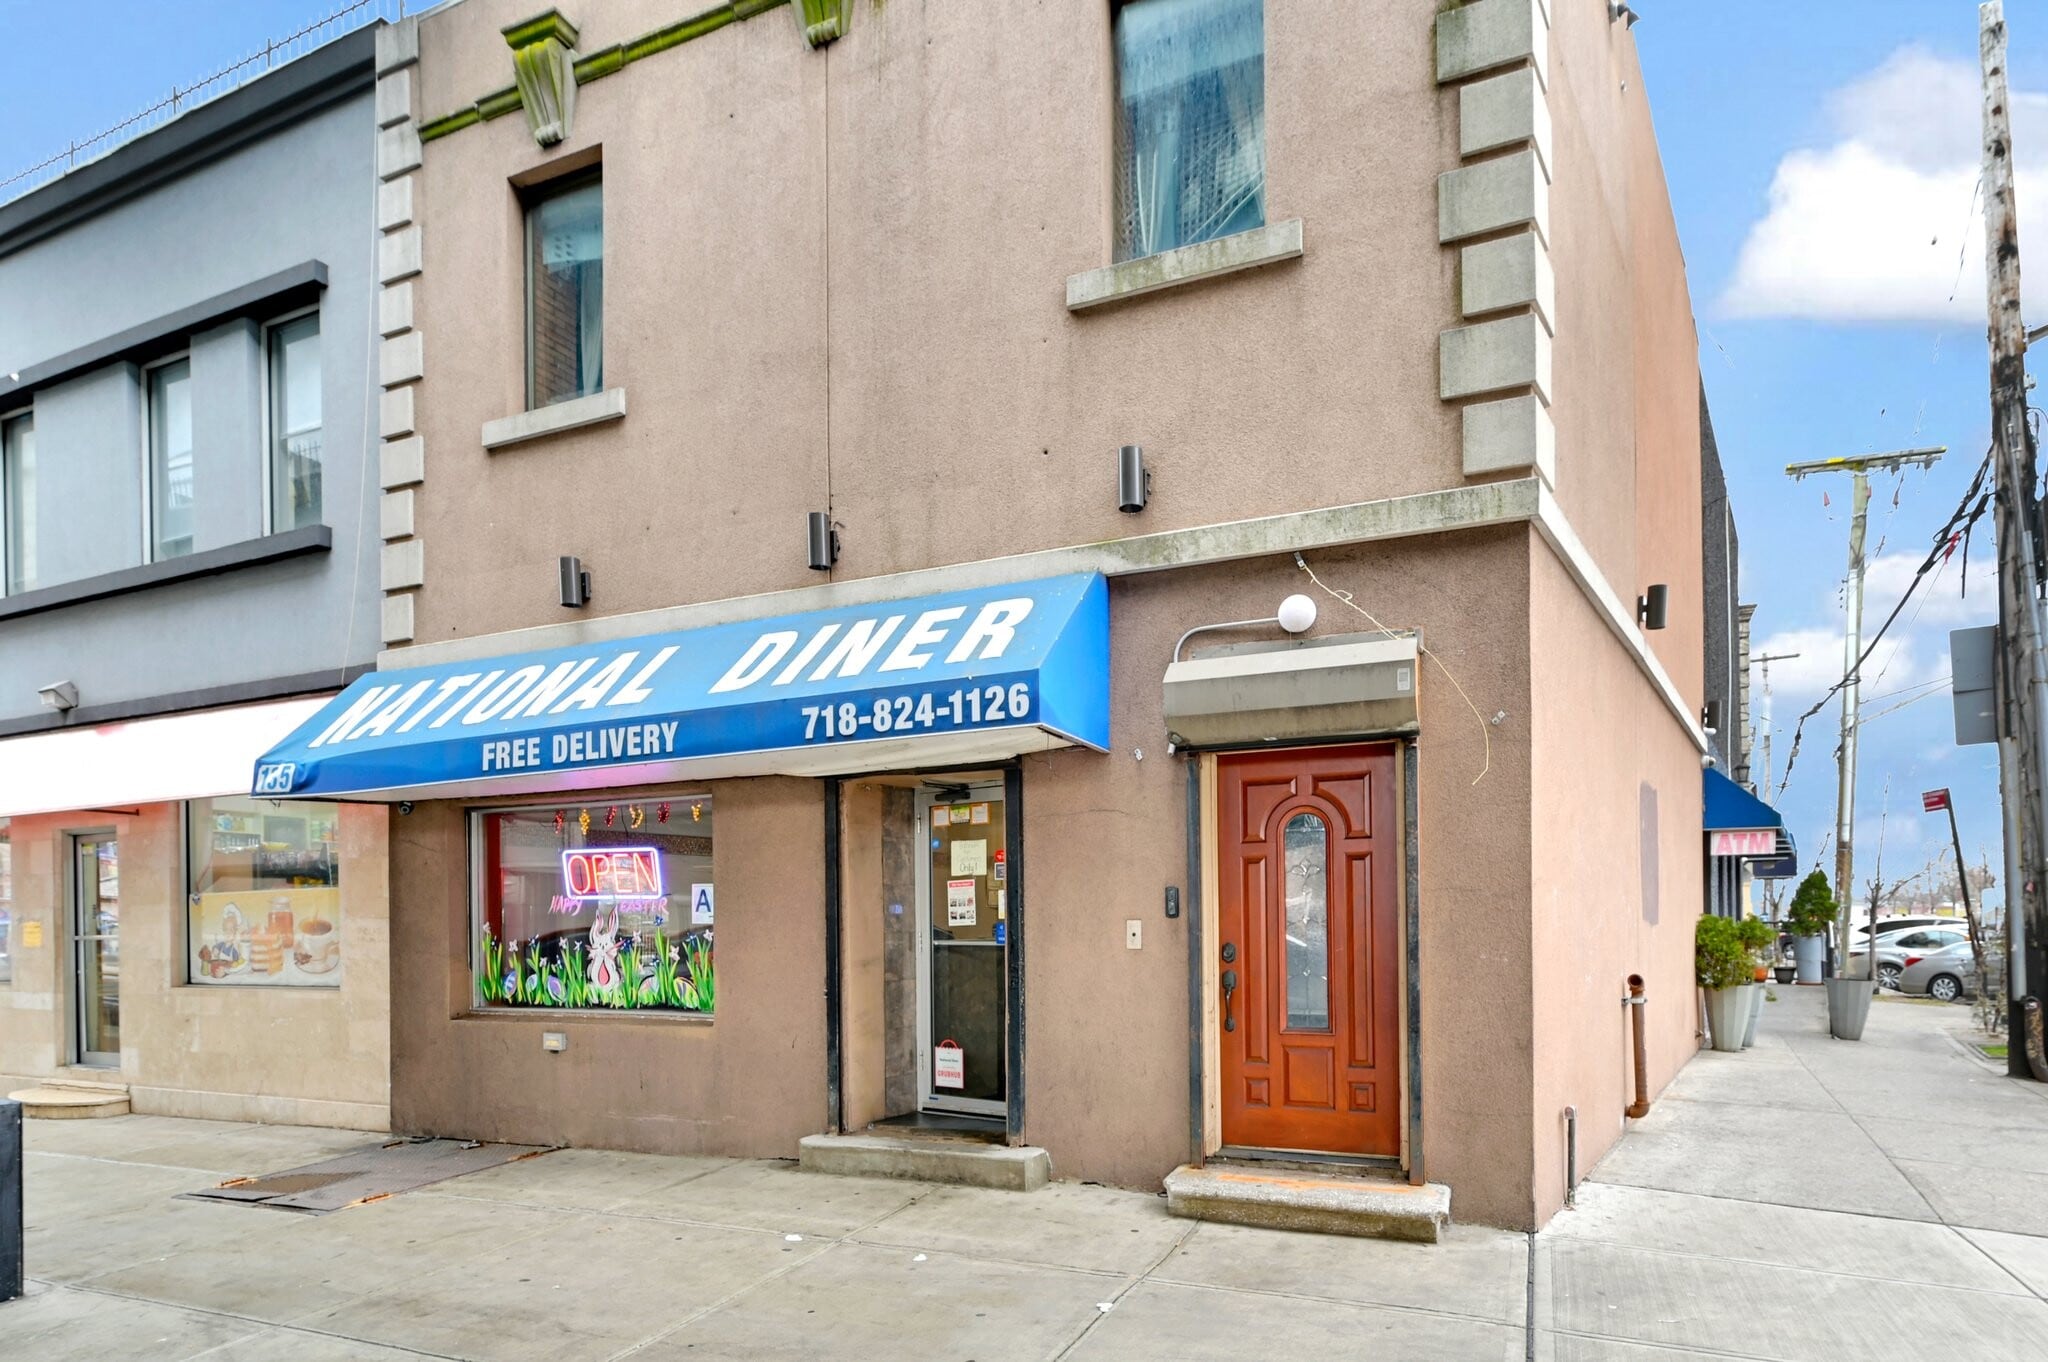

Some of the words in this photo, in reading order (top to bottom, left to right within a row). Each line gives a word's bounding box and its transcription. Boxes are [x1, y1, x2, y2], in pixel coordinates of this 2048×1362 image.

[308, 645, 681, 748] NATIONAL
[707, 597, 1034, 694] DINER
[801, 682, 1030, 740] 718-824-1126
[481, 736, 541, 772] FREE
[552, 720, 679, 764] DELIVERY
[1715, 832, 1770, 854] ATM
[567, 851, 658, 895] OPEN
[548, 895, 583, 916] HAPPY
[619, 897, 670, 915] EASTER
[695, 888, 712, 913] A
